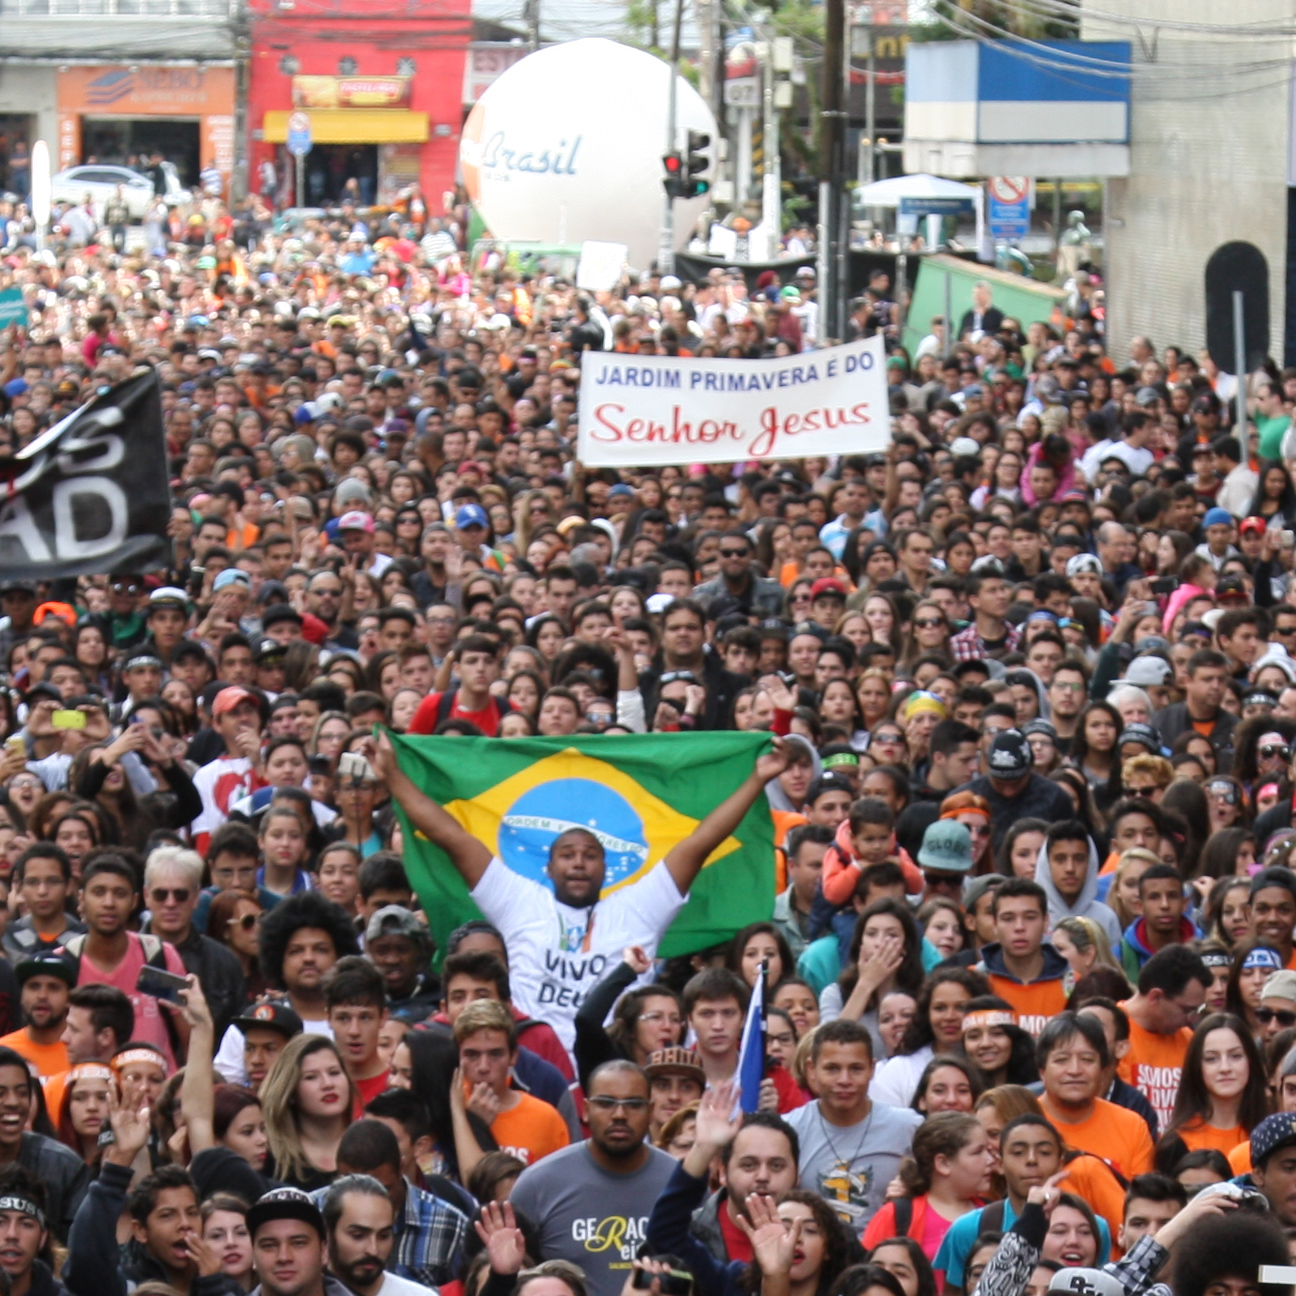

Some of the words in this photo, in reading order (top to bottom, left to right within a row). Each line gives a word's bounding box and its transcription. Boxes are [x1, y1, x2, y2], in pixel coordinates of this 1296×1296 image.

[595, 363, 682, 388] JARDIM
[689, 364, 818, 393] PRIMAVERA
[824, 353, 840, 378] É
[844, 351, 875, 375] DO
[590, 402, 746, 443] Senhor
[744, 400, 871, 456] Jesus
[545, 950, 609, 981] VIVO
